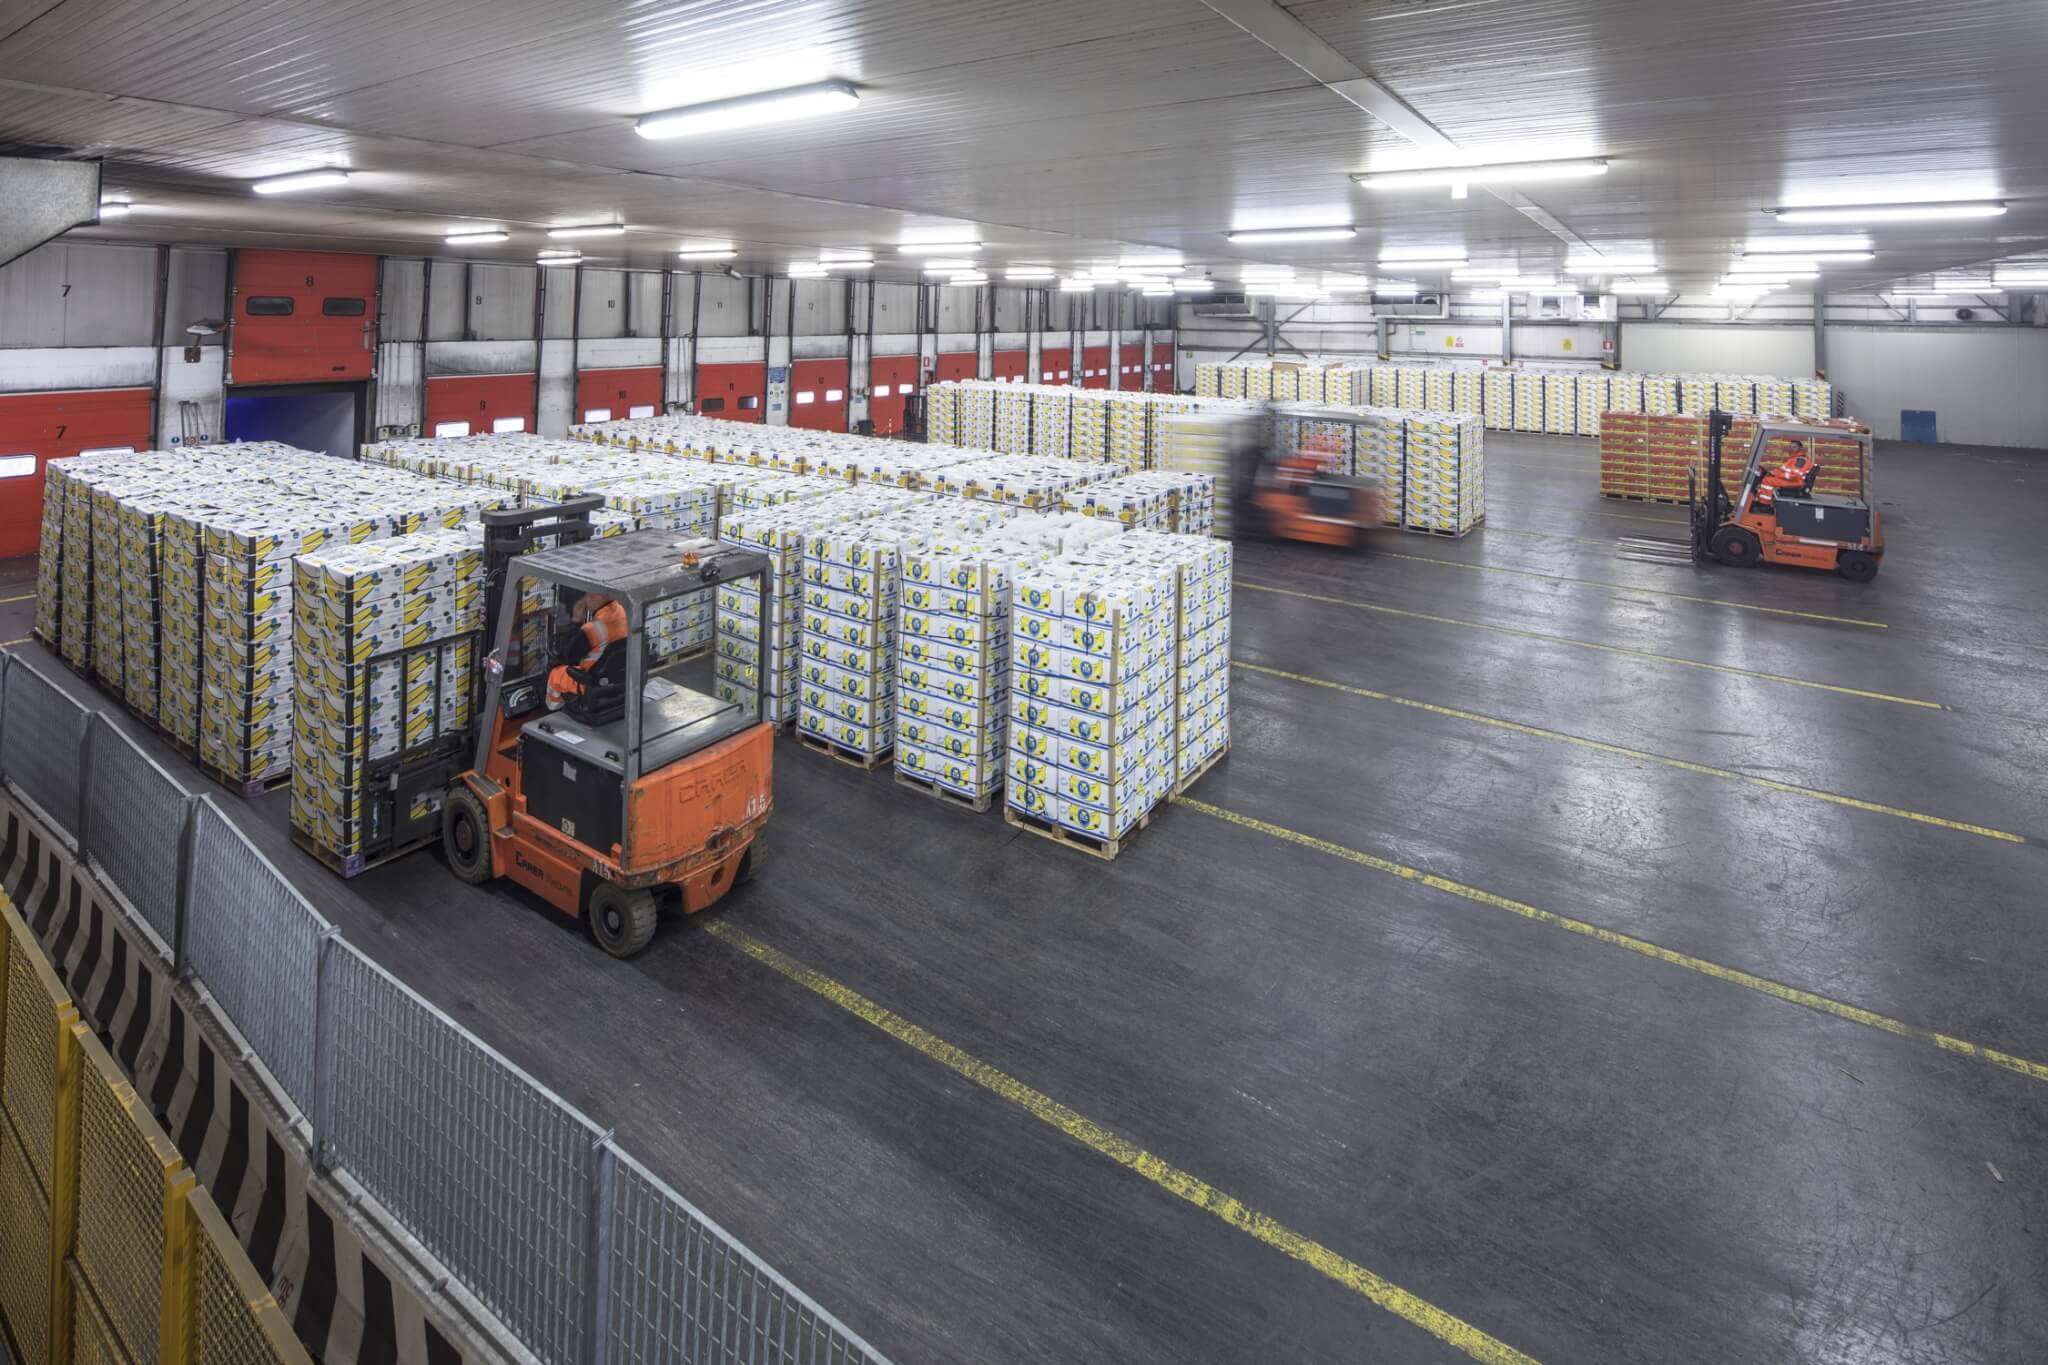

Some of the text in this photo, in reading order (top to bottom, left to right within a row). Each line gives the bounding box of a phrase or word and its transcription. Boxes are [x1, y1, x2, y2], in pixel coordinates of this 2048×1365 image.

[305, 275, 315, 287] 8
[61, 284, 72, 298] 7
[475, 295, 482, 305] 9
[479, 400, 486, 410] 9
[56, 424, 67, 439] 7
[679, 759, 747, 804] CARER
